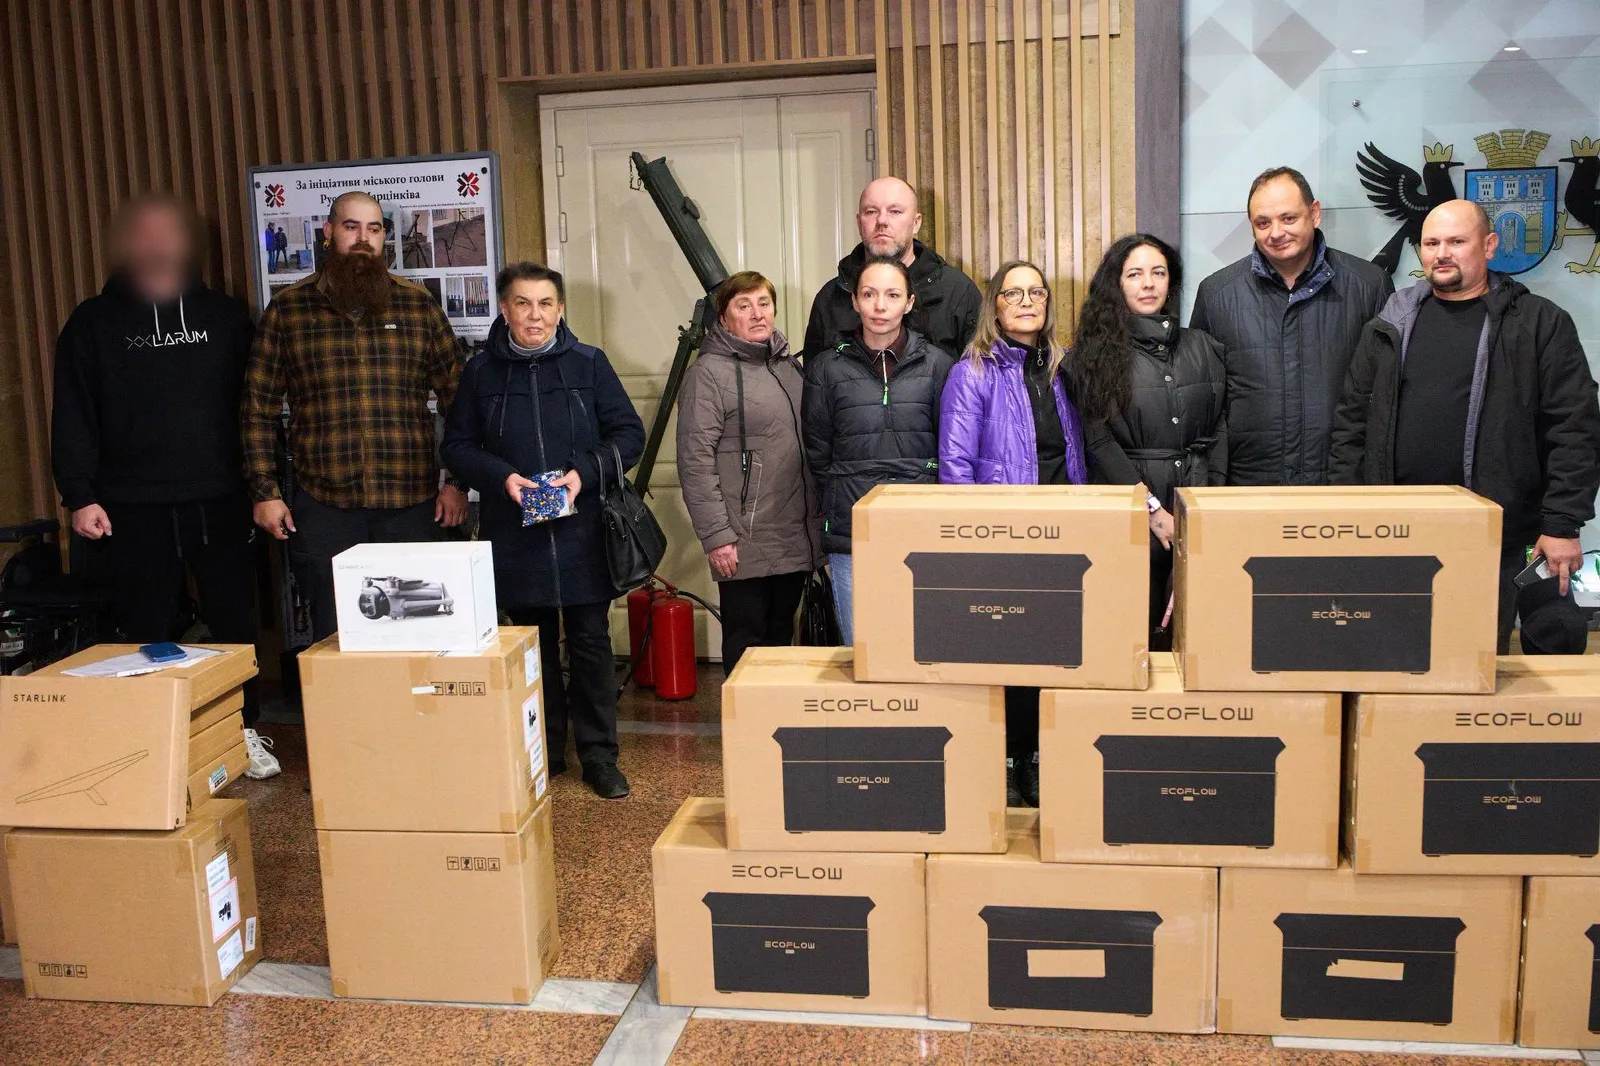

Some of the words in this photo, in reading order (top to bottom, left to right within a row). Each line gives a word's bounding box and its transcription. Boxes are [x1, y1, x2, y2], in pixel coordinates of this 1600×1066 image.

[296, 180, 307, 190] За
[309, 177, 361, 189] ініціативи
[363, 175, 406, 186] міського
[409, 174, 444, 183] голови
[367, 190, 420, 203] арцінківа
[940, 525, 1060, 540] ECOFLOW
[1282, 524, 1410, 540] ECOFLOW
[969, 605, 1025, 614] ECOFLOW
[1311, 611, 1371, 619] ECOFLOW
[13, 694, 67, 703] STARLINK
[803, 698, 919, 712] ECOFLOW
[1131, 706, 1254, 721] ECOFLOW
[1455, 712, 1582, 727] ECOFLOW
[836, 776, 890, 784] ECOFLOW
[1160, 787, 1217, 796] ECOFLOW
[1483, 795, 1542, 804] ECOFLOW
[731, 864, 843, 881] ECOFLOW
[764, 940, 816, 950] ECOFLOW
